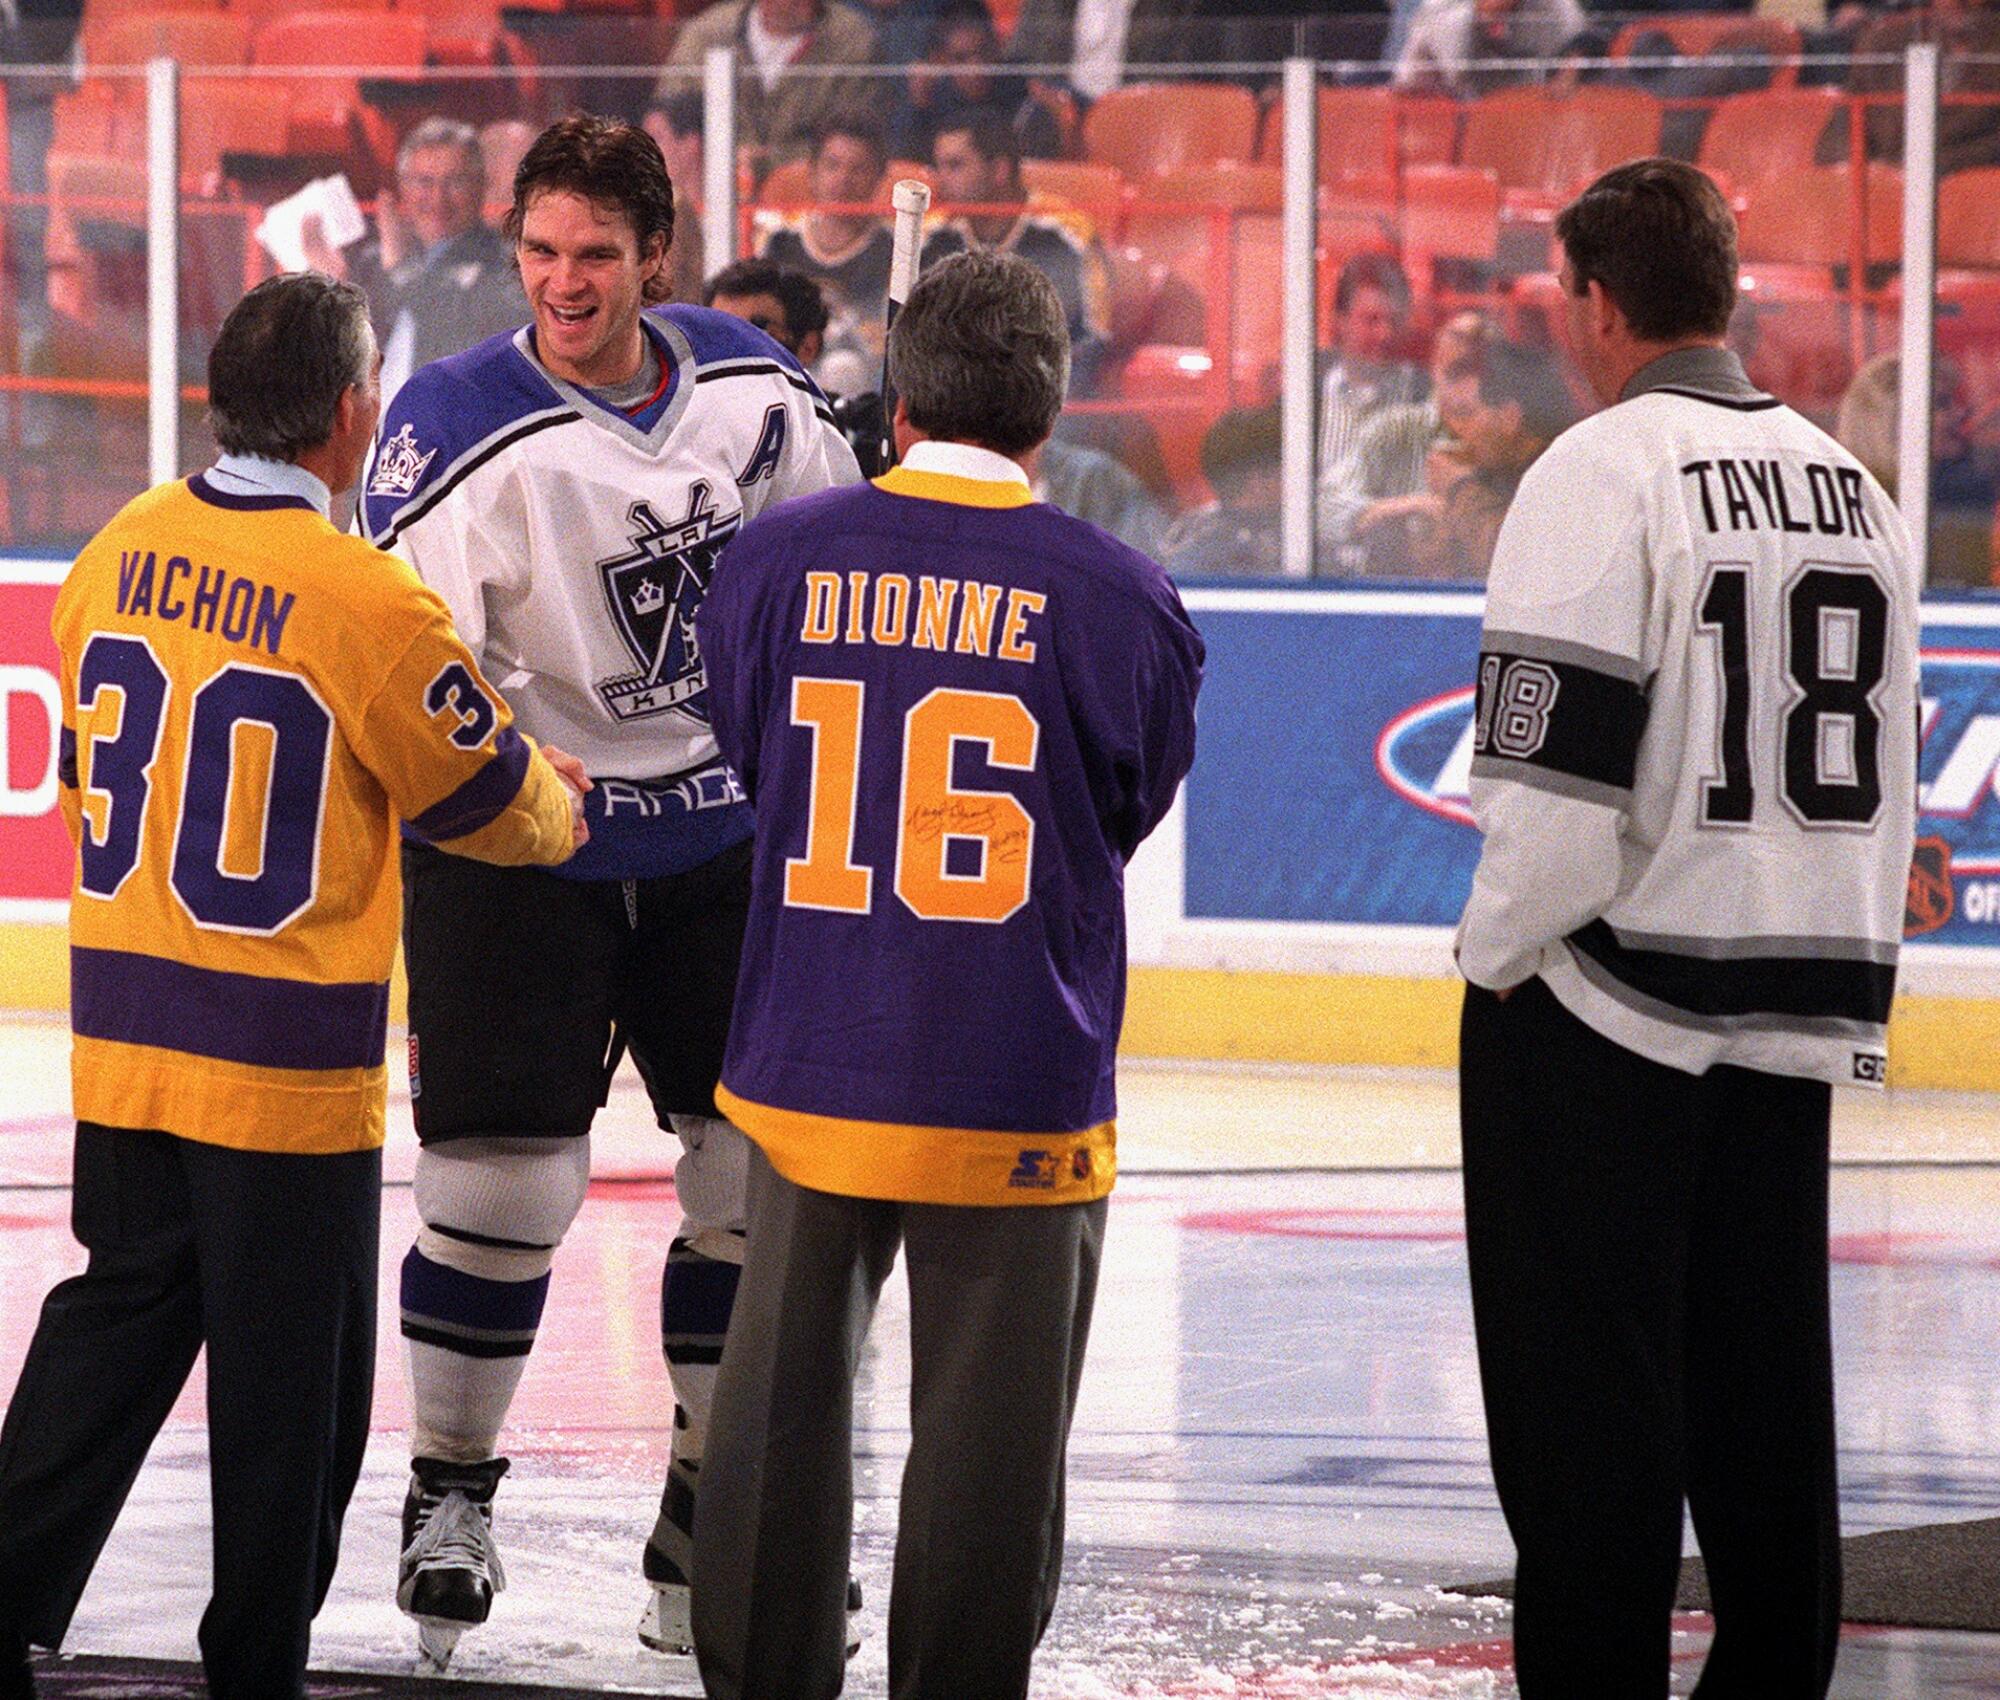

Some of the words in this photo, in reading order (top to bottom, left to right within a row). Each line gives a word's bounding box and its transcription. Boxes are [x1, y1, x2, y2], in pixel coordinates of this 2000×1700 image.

[736, 402, 788, 486] A
[659, 526, 699, 553] LA
[1682, 460, 1872, 538] TAYLOR
[116, 551, 295, 654] VACHON
[800, 571, 1046, 663] DIONNE
[422, 660, 498, 750] 3
[1475, 656, 1560, 758] 18
[1695, 559, 1895, 832] 18
[76, 629, 334, 938] 30
[784, 676, 1039, 923] 16
